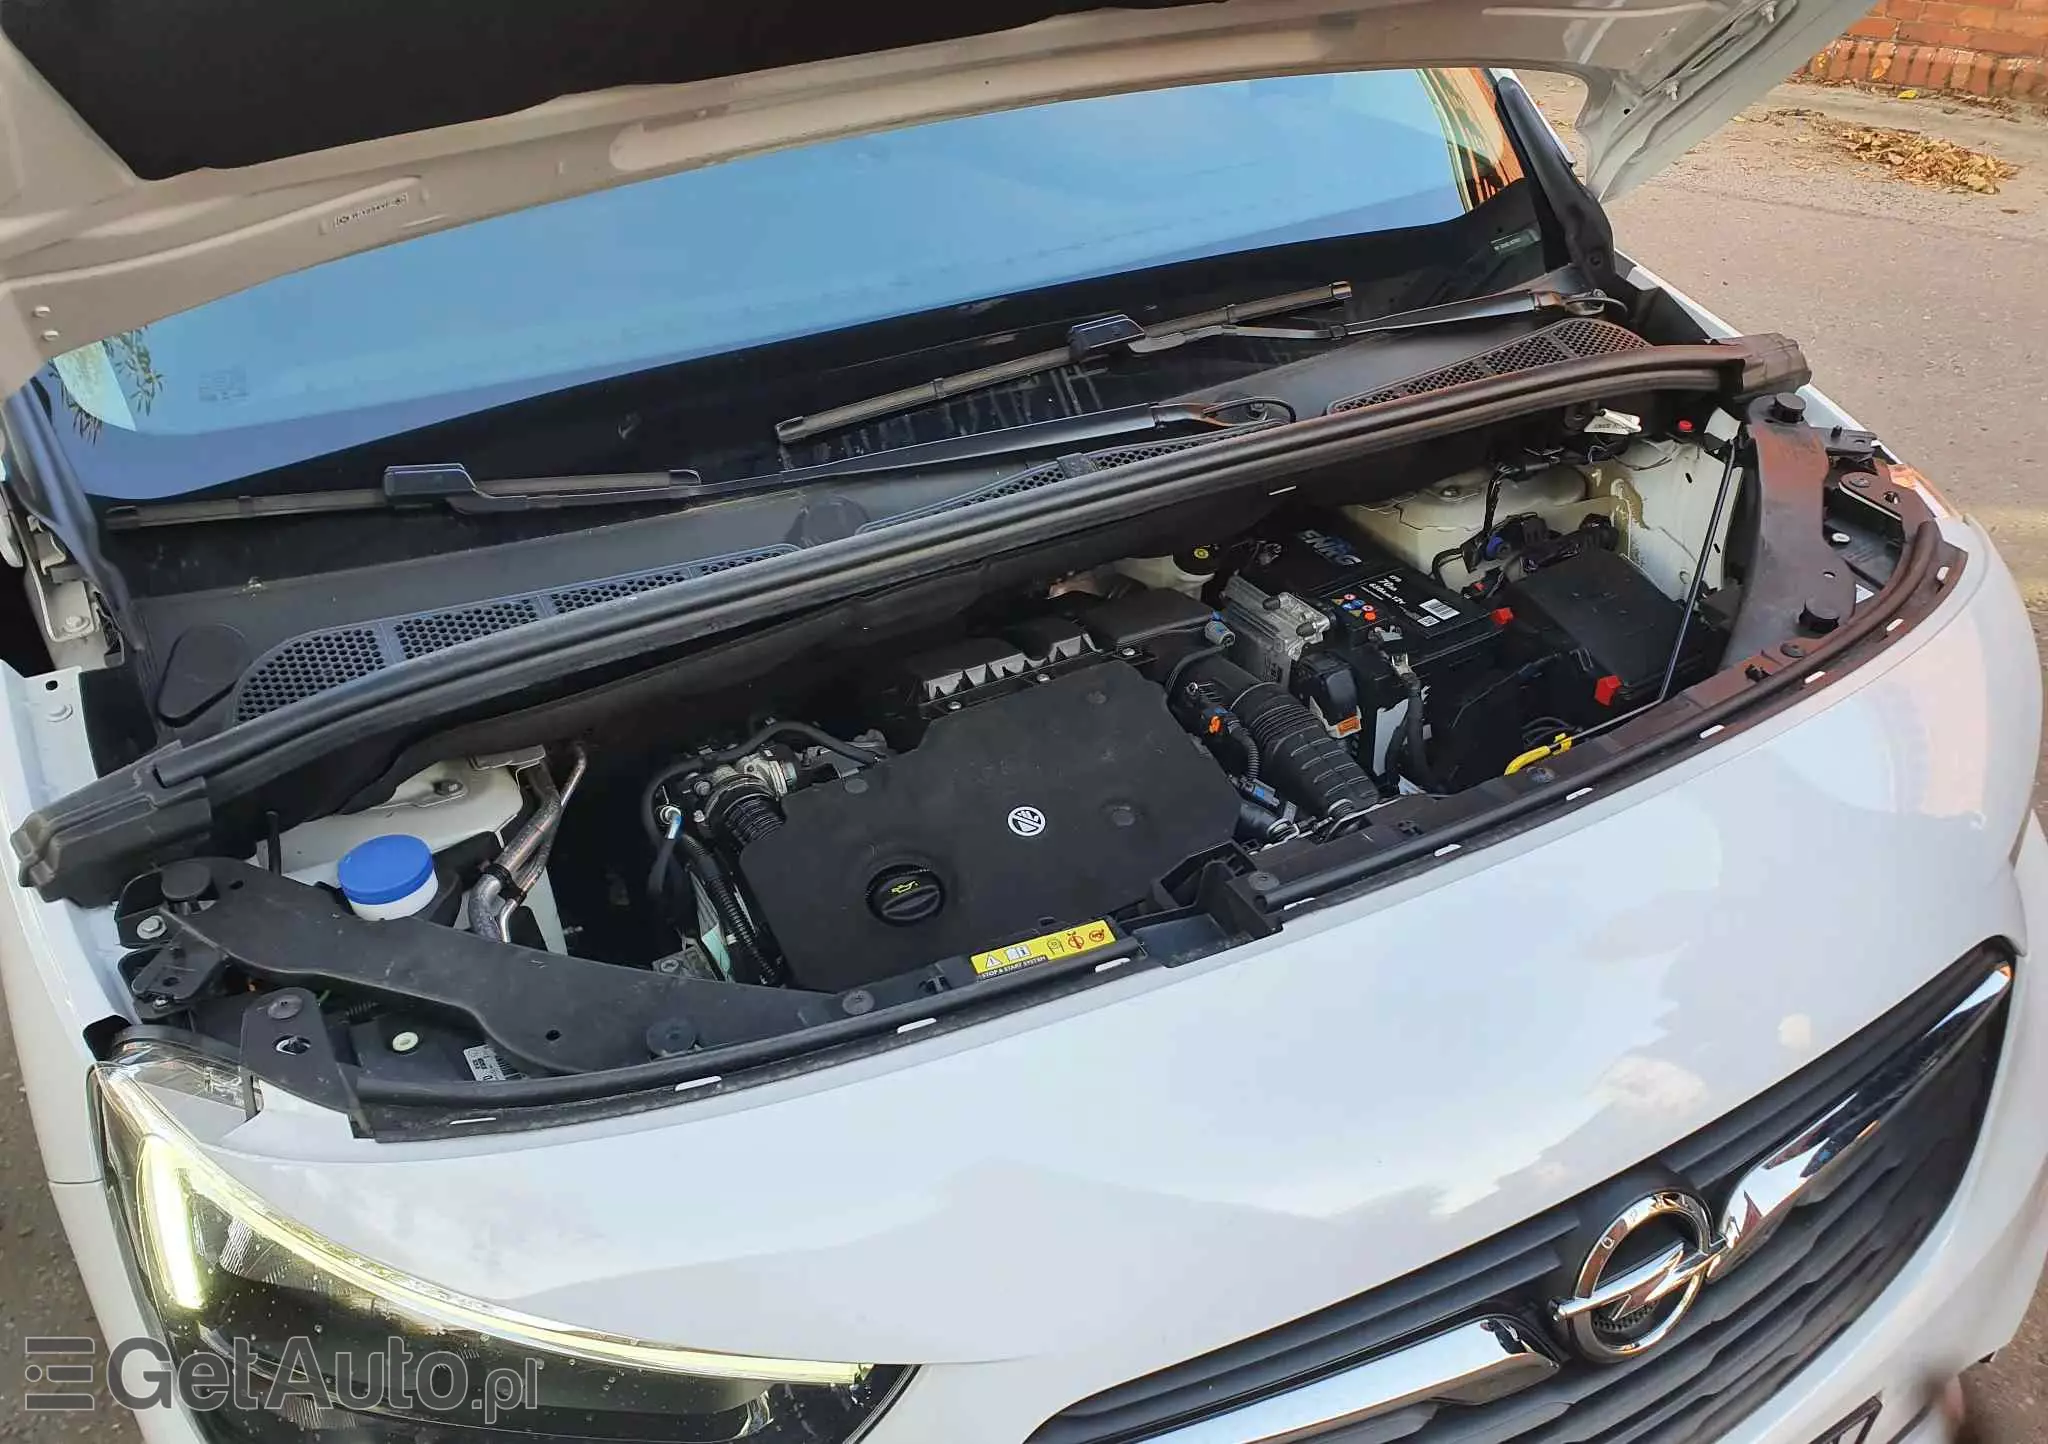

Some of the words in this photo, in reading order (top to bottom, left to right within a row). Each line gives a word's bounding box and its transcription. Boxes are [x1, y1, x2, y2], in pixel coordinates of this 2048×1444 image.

[981, 970, 998, 978] STOP
[1004, 962, 1022, 972] START
[1022, 956, 1047, 967] SYSTEM
